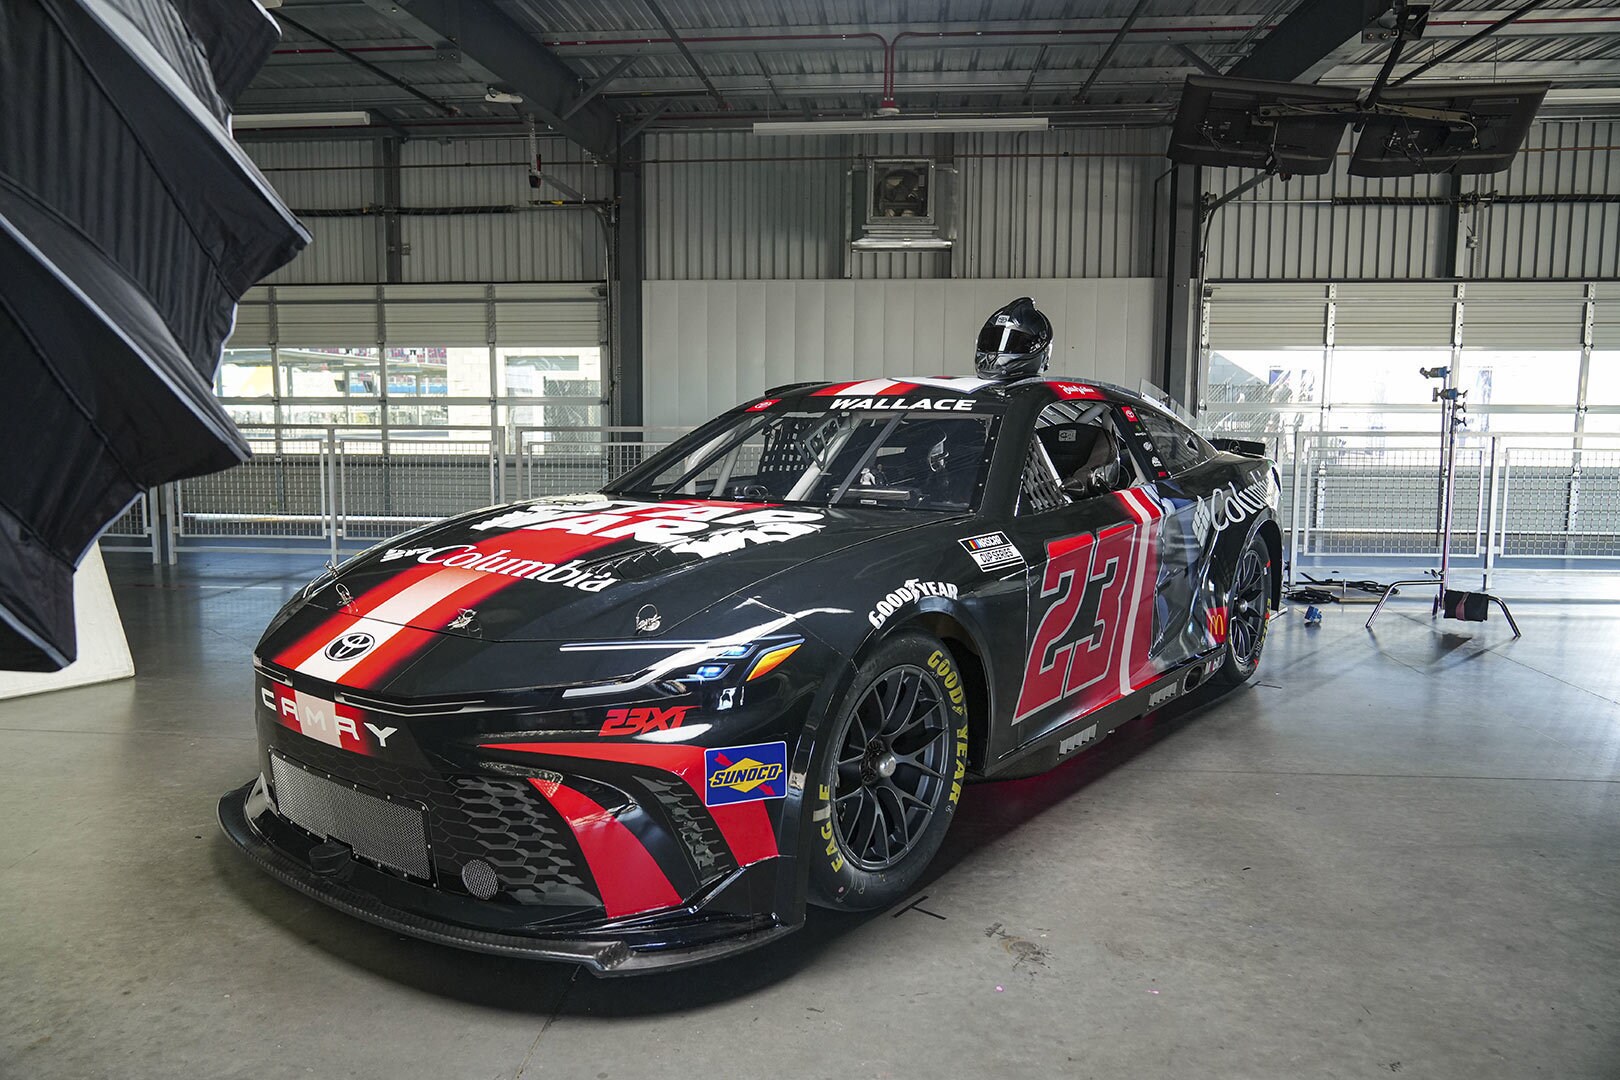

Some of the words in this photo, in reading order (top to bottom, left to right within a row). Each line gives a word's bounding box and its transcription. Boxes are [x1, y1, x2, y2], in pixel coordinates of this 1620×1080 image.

[830, 398, 977, 411] WALLACE
[528, 500, 825, 524] STAR
[978, 535, 1003, 549] NASCAR
[980, 552, 993, 563] CUP
[992, 547, 1014, 561] SERIES
[417, 545, 620, 593] Columbia
[1012, 520, 1137, 725] 23
[261, 687, 398, 748] CAMRY
[711, 765, 781, 786] SUNOCO
[812, 783, 842, 872] EAGLE
